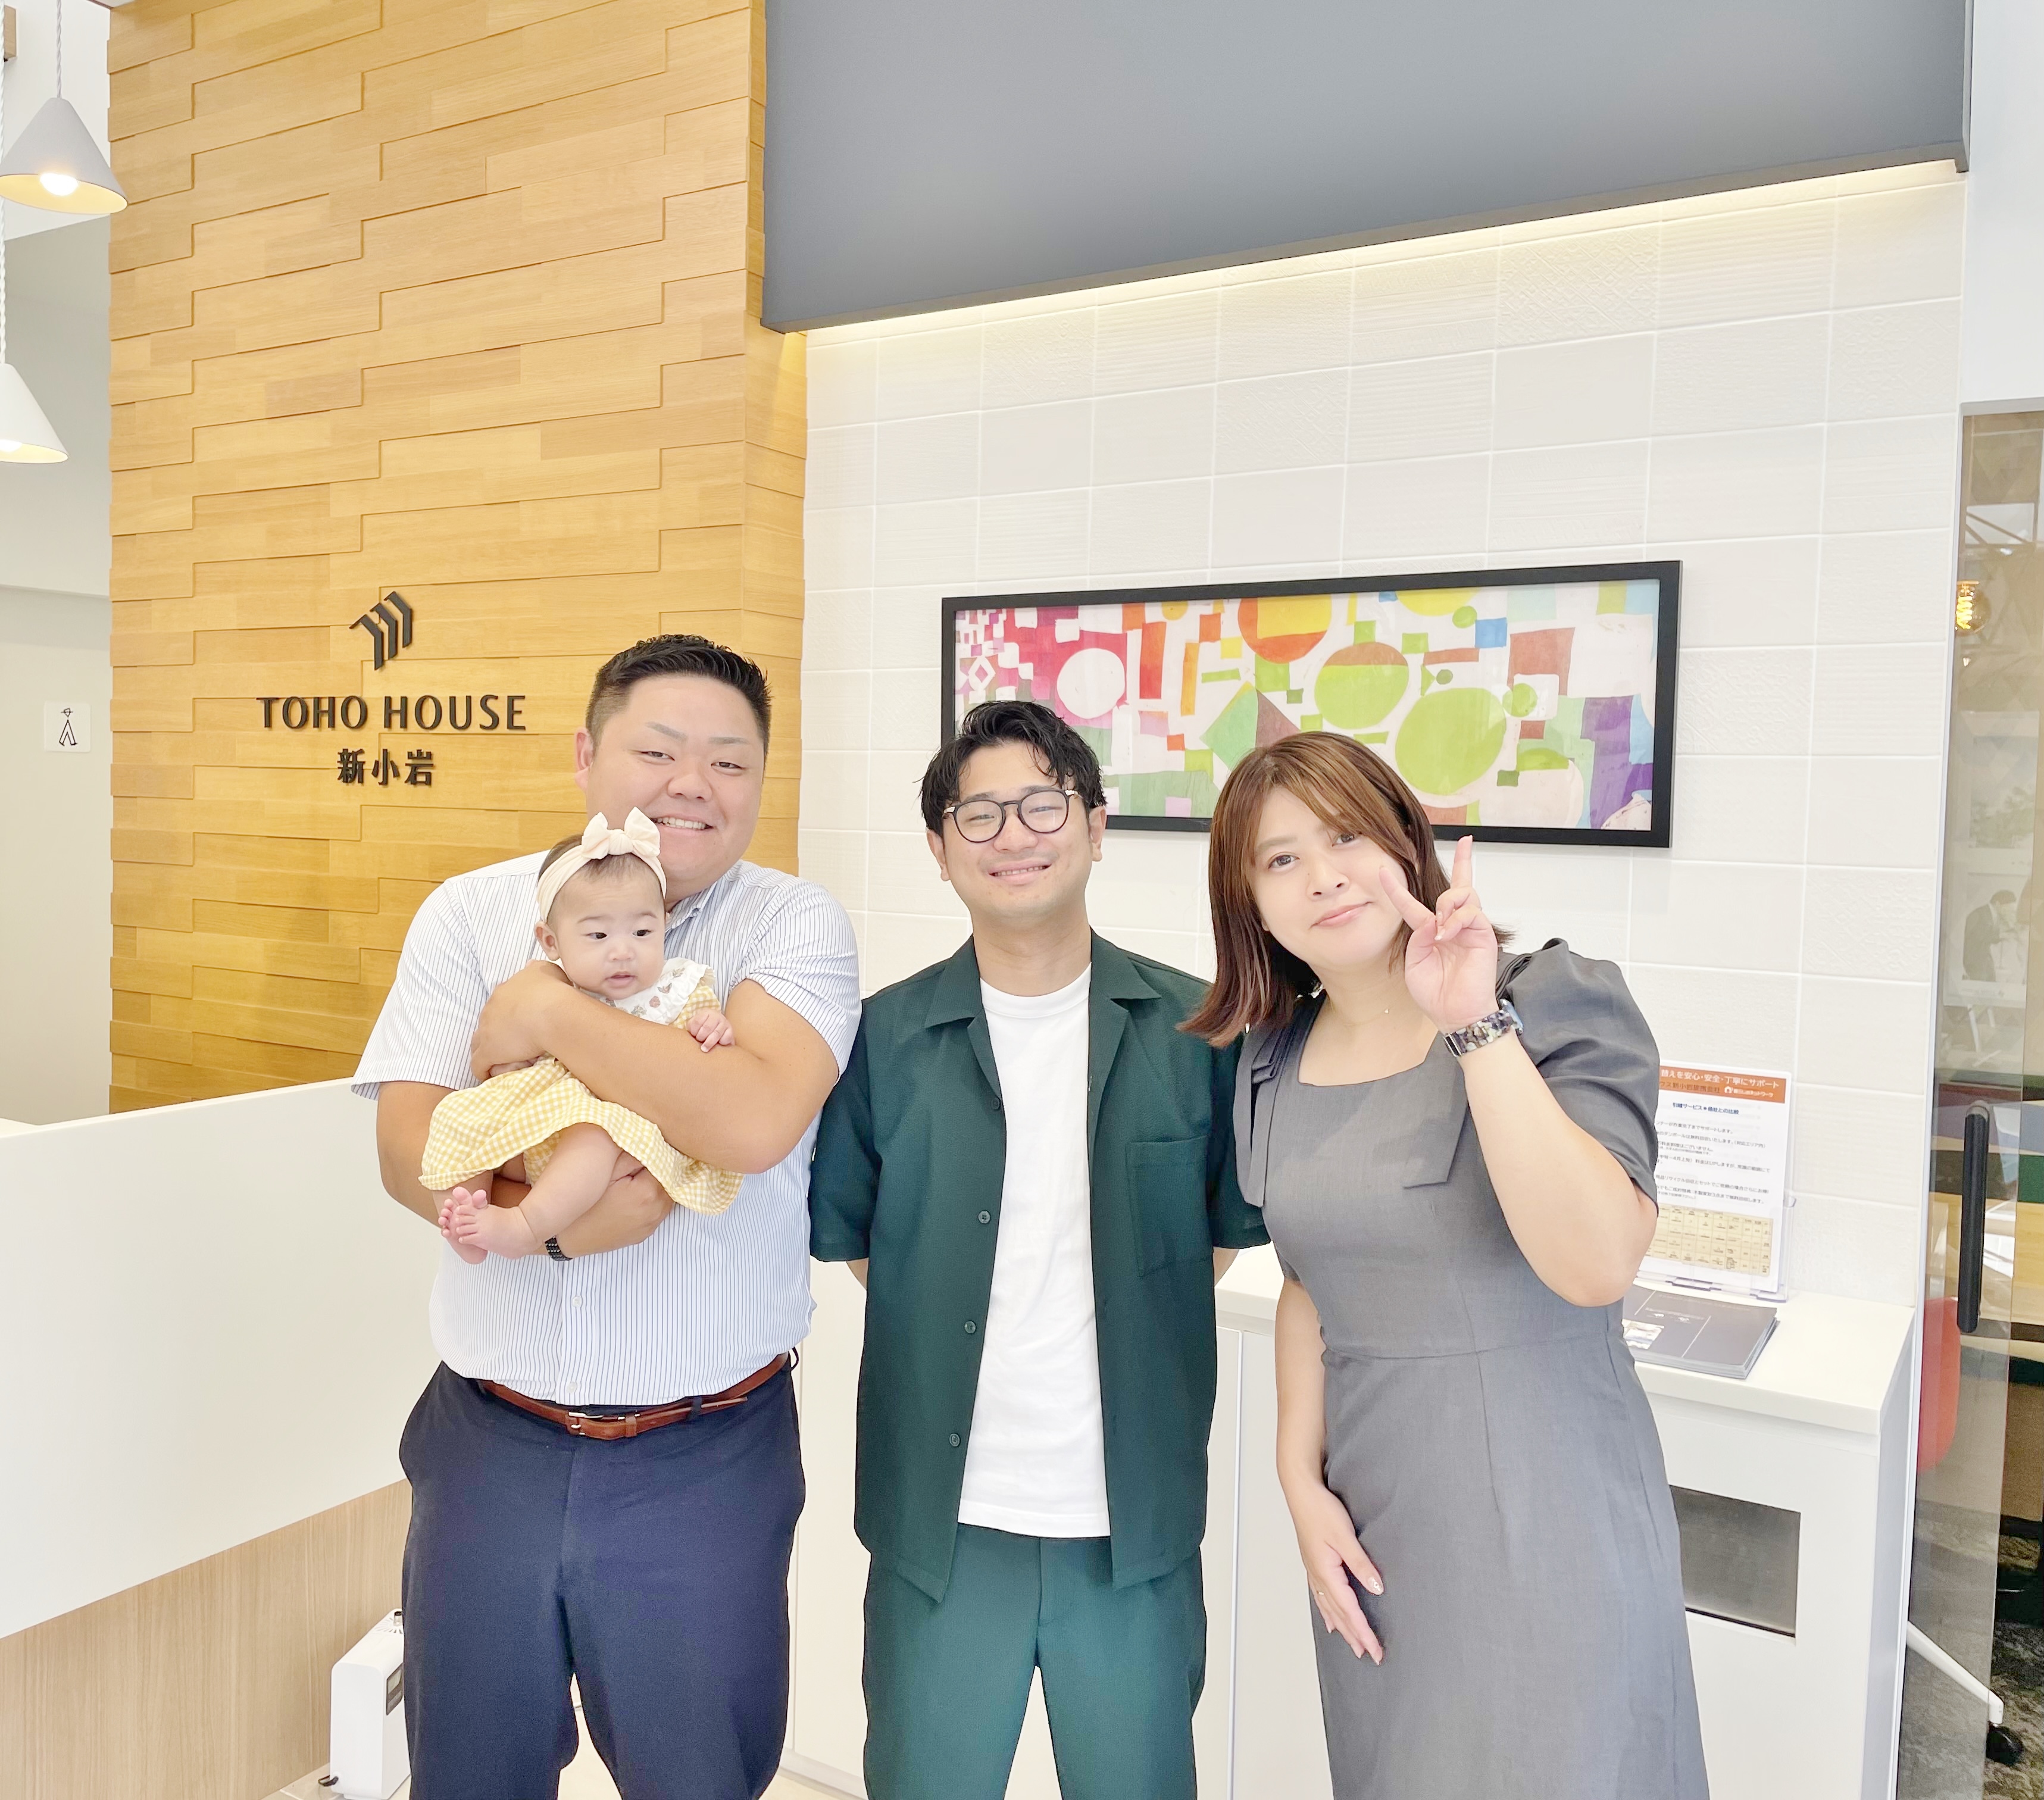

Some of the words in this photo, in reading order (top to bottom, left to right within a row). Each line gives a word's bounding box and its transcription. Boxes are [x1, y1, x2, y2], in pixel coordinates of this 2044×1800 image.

[256, 695, 368, 730] TOHO
[383, 694, 526, 730] HOUSE
[337, 748, 434, 785] 新小岩
